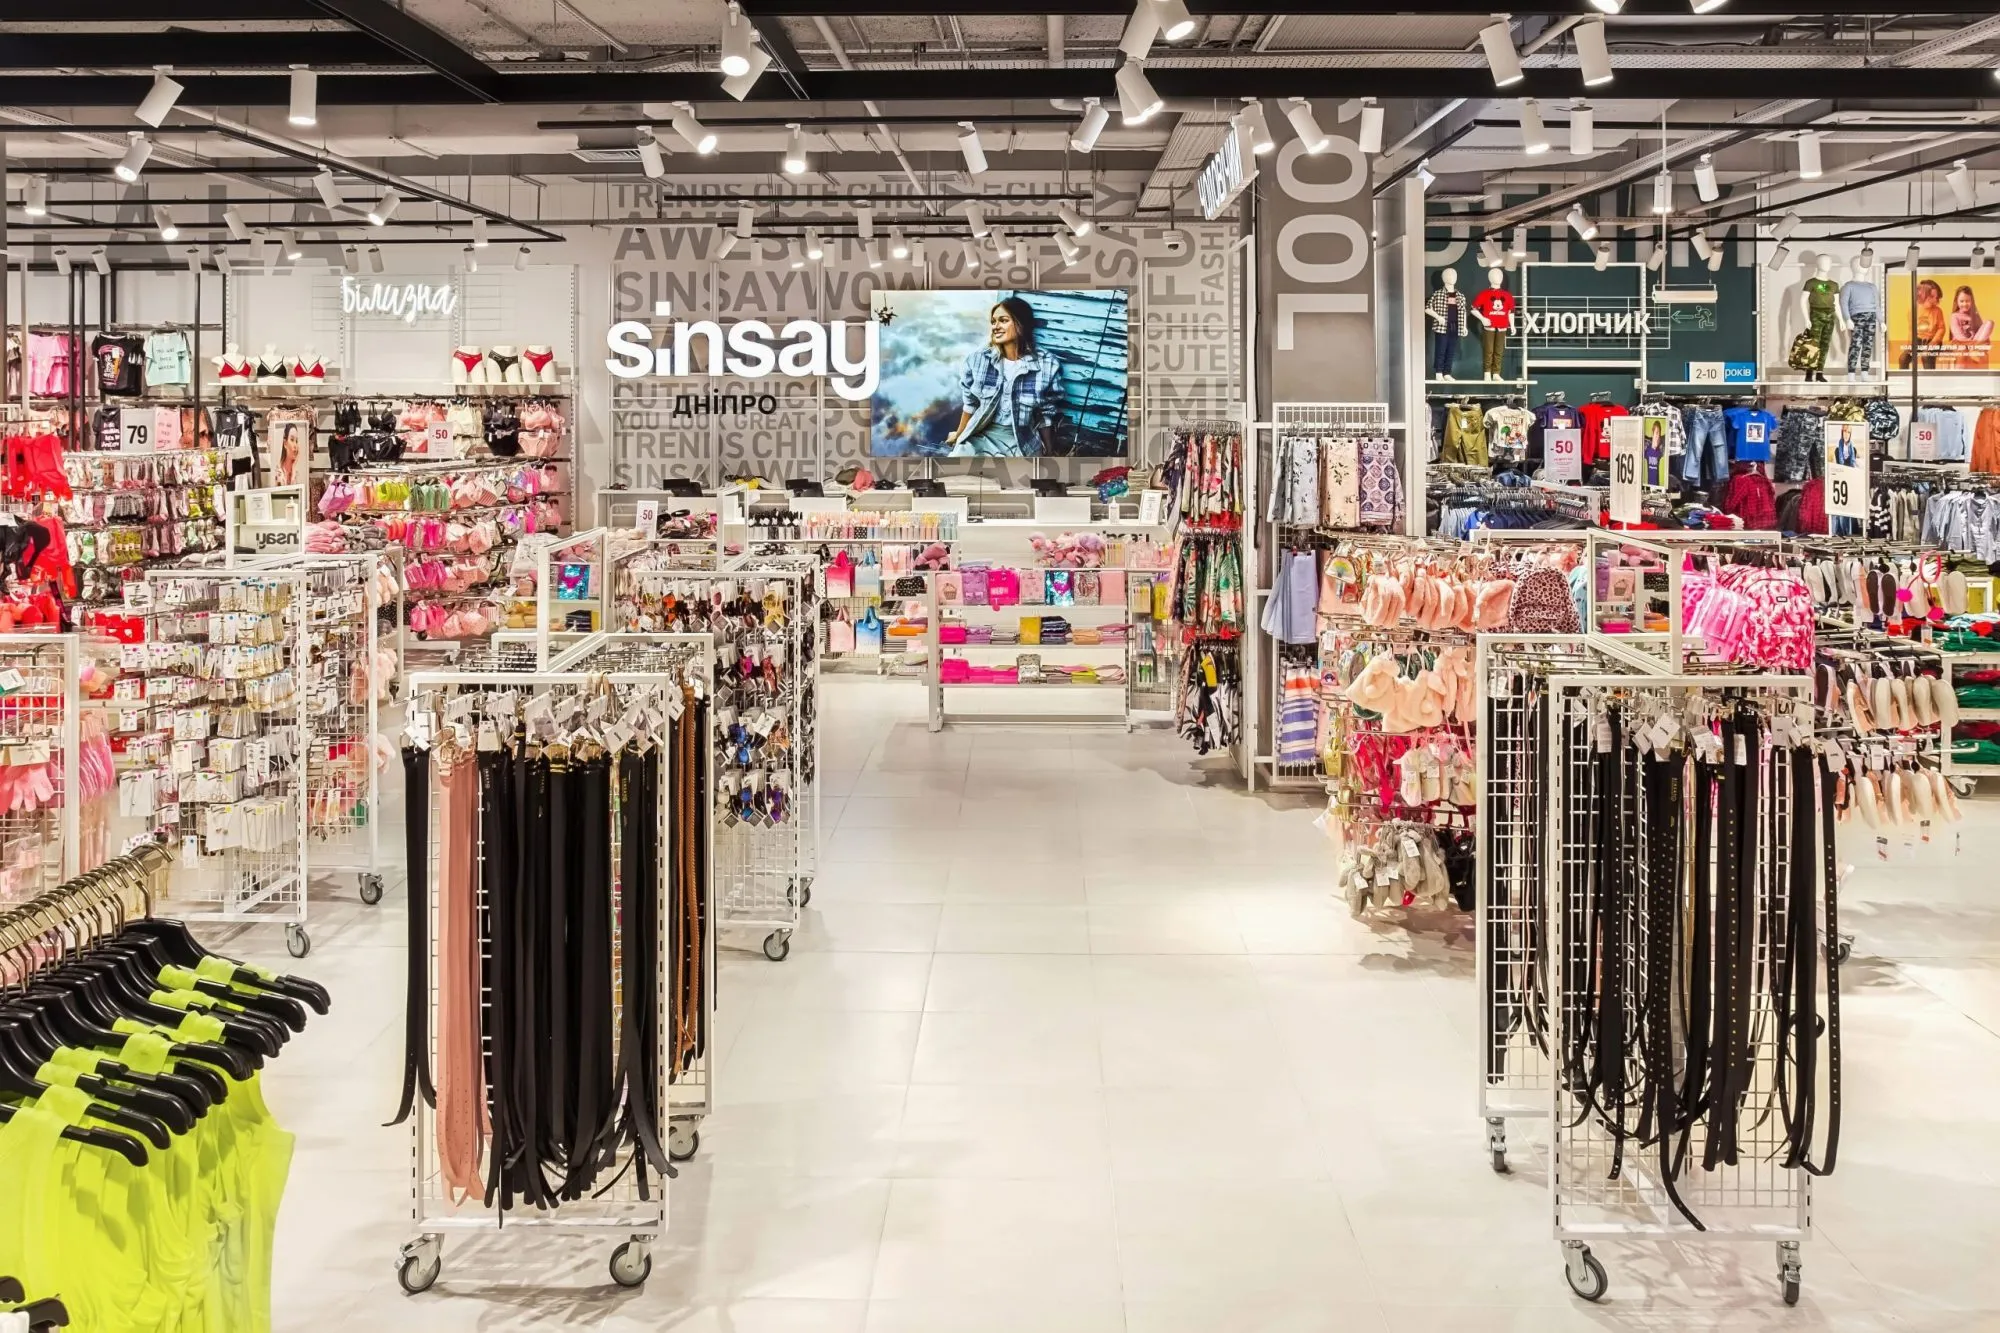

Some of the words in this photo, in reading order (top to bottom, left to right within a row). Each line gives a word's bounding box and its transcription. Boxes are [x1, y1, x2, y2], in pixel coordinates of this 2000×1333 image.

[612, 184, 742, 207] TRENDS
[754, 184, 839, 207] CUTE
[1522, 312, 1651, 335] ХЛОПЧИК
[604, 301, 879, 400] sinsay
[1147, 344, 1227, 371] CUTE
[1695, 368, 1717, 380] 2-10
[1724, 366, 1752, 379] років
[616, 412, 660, 430] YOU
[733, 412, 806, 430] GREAT
[127, 425, 148, 444] 79
[432, 429, 448, 439] -50
[1914, 430, 1932, 441] -50
[615, 431, 745, 458] TRENDS
[1550, 440, 1573, 454] -50
[1615, 453, 1635, 484] 169
[1833, 480, 1848, 506] 59
[640, 509, 653, 520] -50
